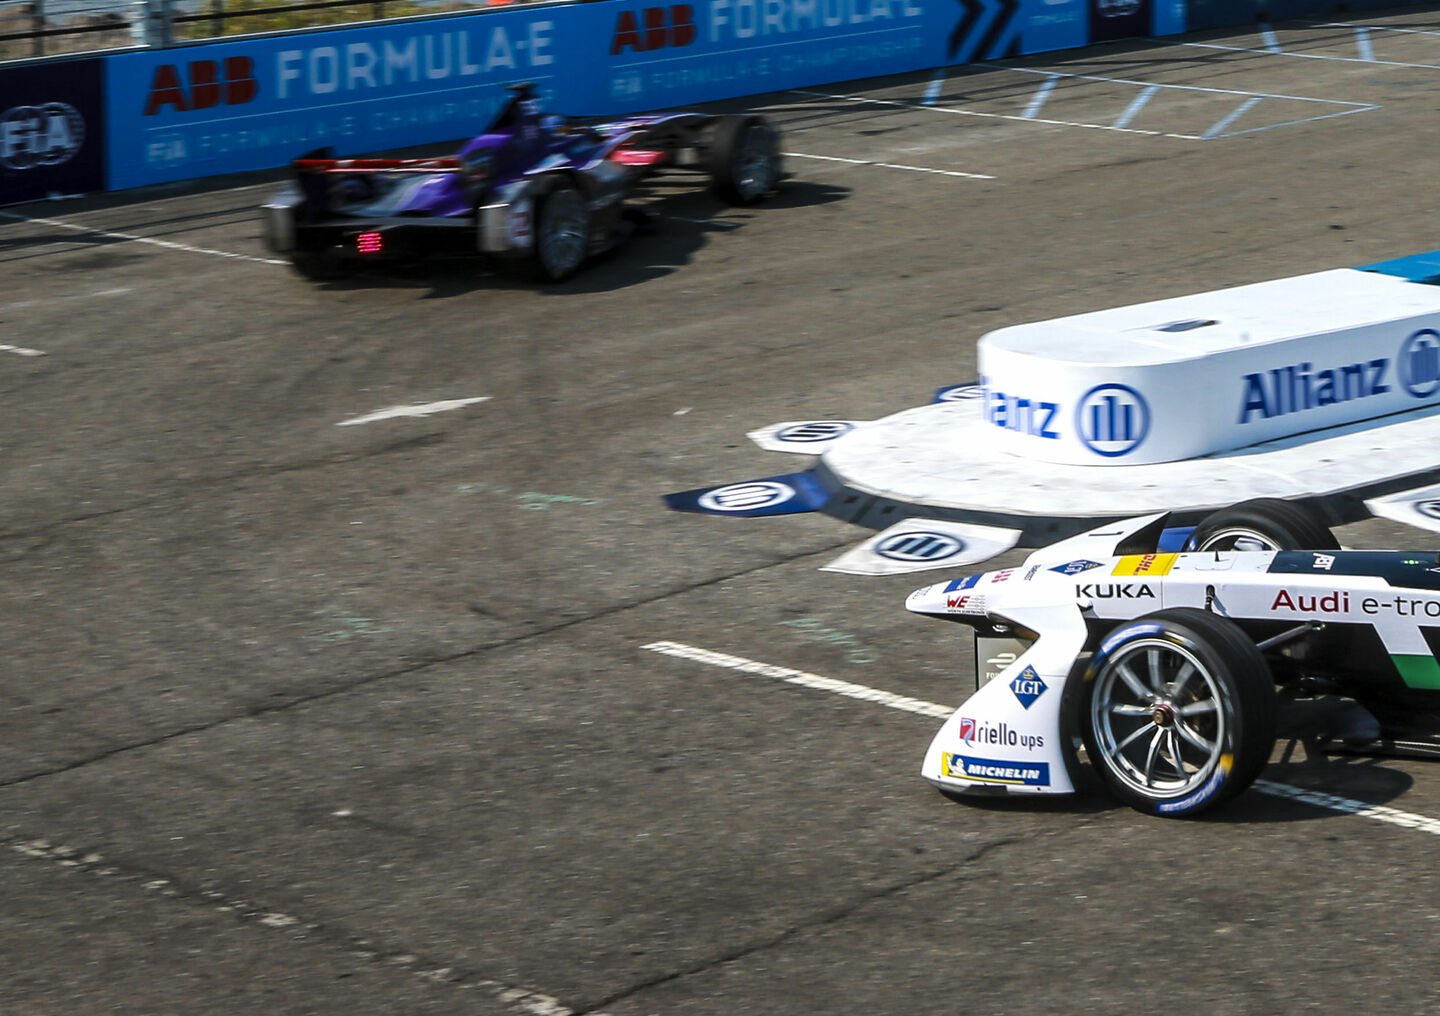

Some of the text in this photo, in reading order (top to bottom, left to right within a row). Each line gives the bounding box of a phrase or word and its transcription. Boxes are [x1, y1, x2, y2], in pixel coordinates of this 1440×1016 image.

[608, 4, 696, 55] ABB
[143, 21, 553, 116] ABB FORMULA-E
[0, 115, 71, 158] FIA
[1239, 357, 1391, 424] Allianz
[947, 594, 971, 608] WE
[1076, 584, 1156, 598] KUKA
[1271, 589, 1350, 613] Audi
[1014, 679, 1043, 696] LGT
[977, 721, 1044, 751] riello ups
[967, 763, 1041, 780] MICHELIN
